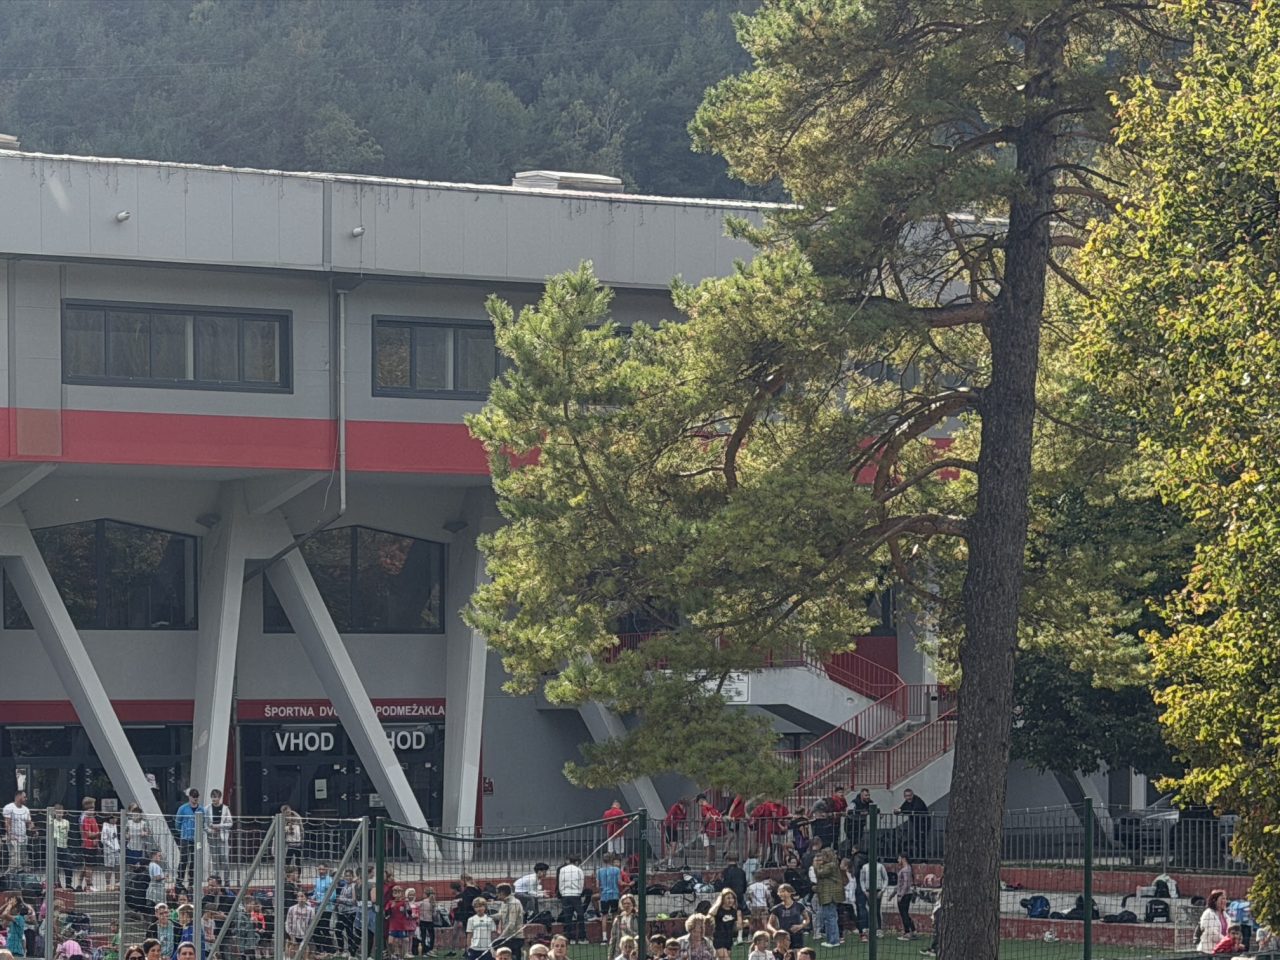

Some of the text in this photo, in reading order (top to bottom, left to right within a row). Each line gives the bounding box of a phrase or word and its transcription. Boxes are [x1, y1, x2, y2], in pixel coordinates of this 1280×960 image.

[264, 704, 315, 717] ŠPORTNA
[375, 703, 445, 716] PODMEŽAKLA
[275, 732, 335, 751] VHOD
